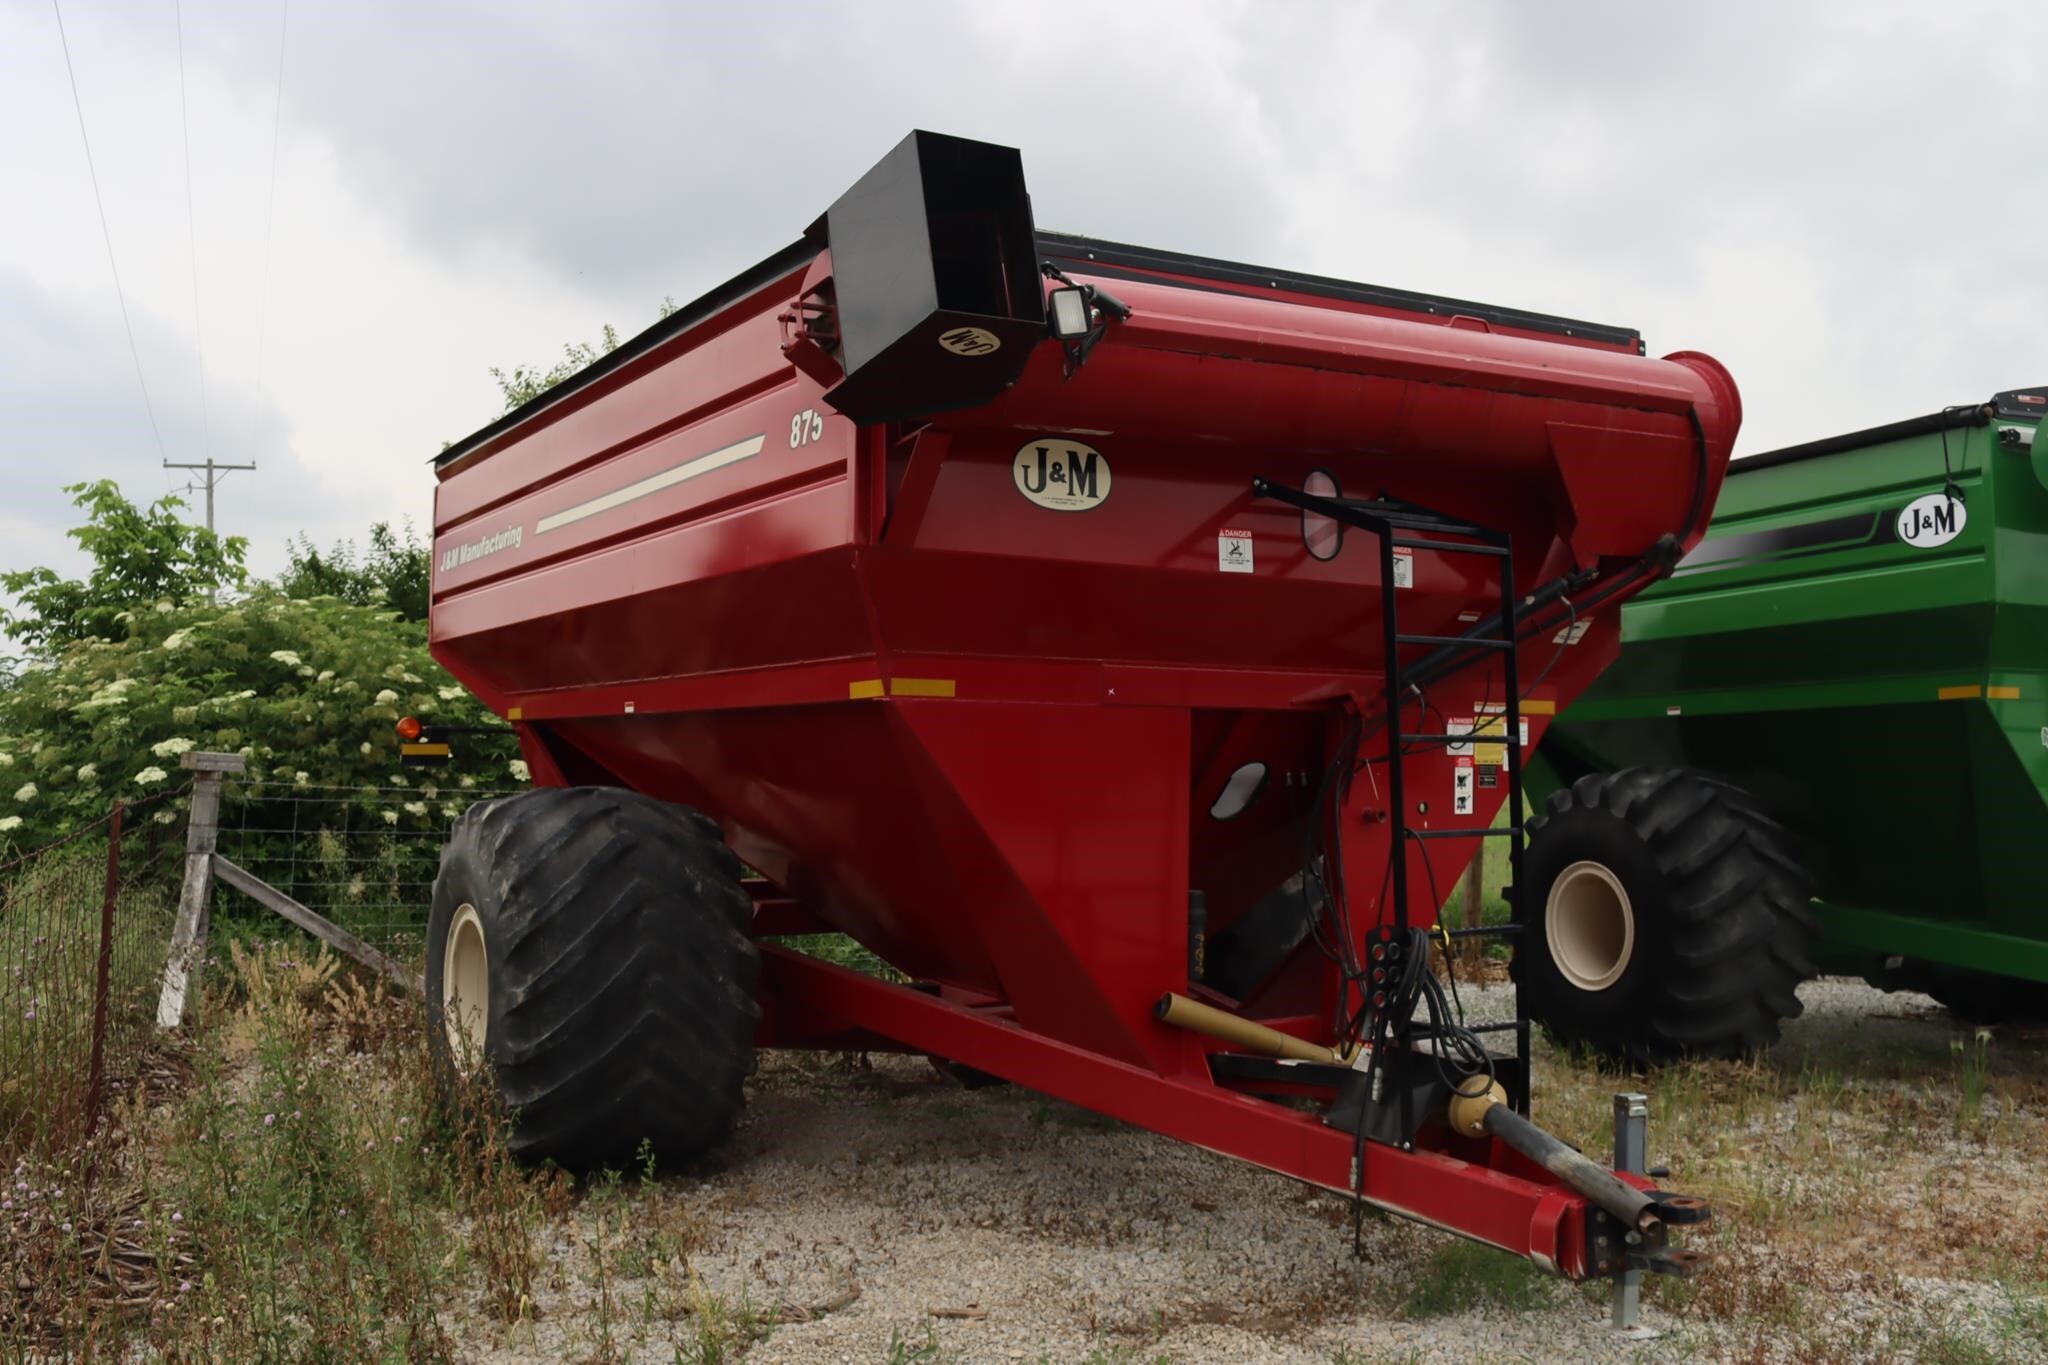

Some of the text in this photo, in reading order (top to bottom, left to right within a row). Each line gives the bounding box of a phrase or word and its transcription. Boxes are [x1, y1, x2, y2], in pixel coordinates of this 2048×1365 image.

[790, 409, 823, 449] 875
[1021, 446, 1100, 499] J&M
[1224, 529, 1252, 538] DANGER
[1903, 502, 1956, 540] J&M
[440, 524, 523, 573] J&M Manufacturing
